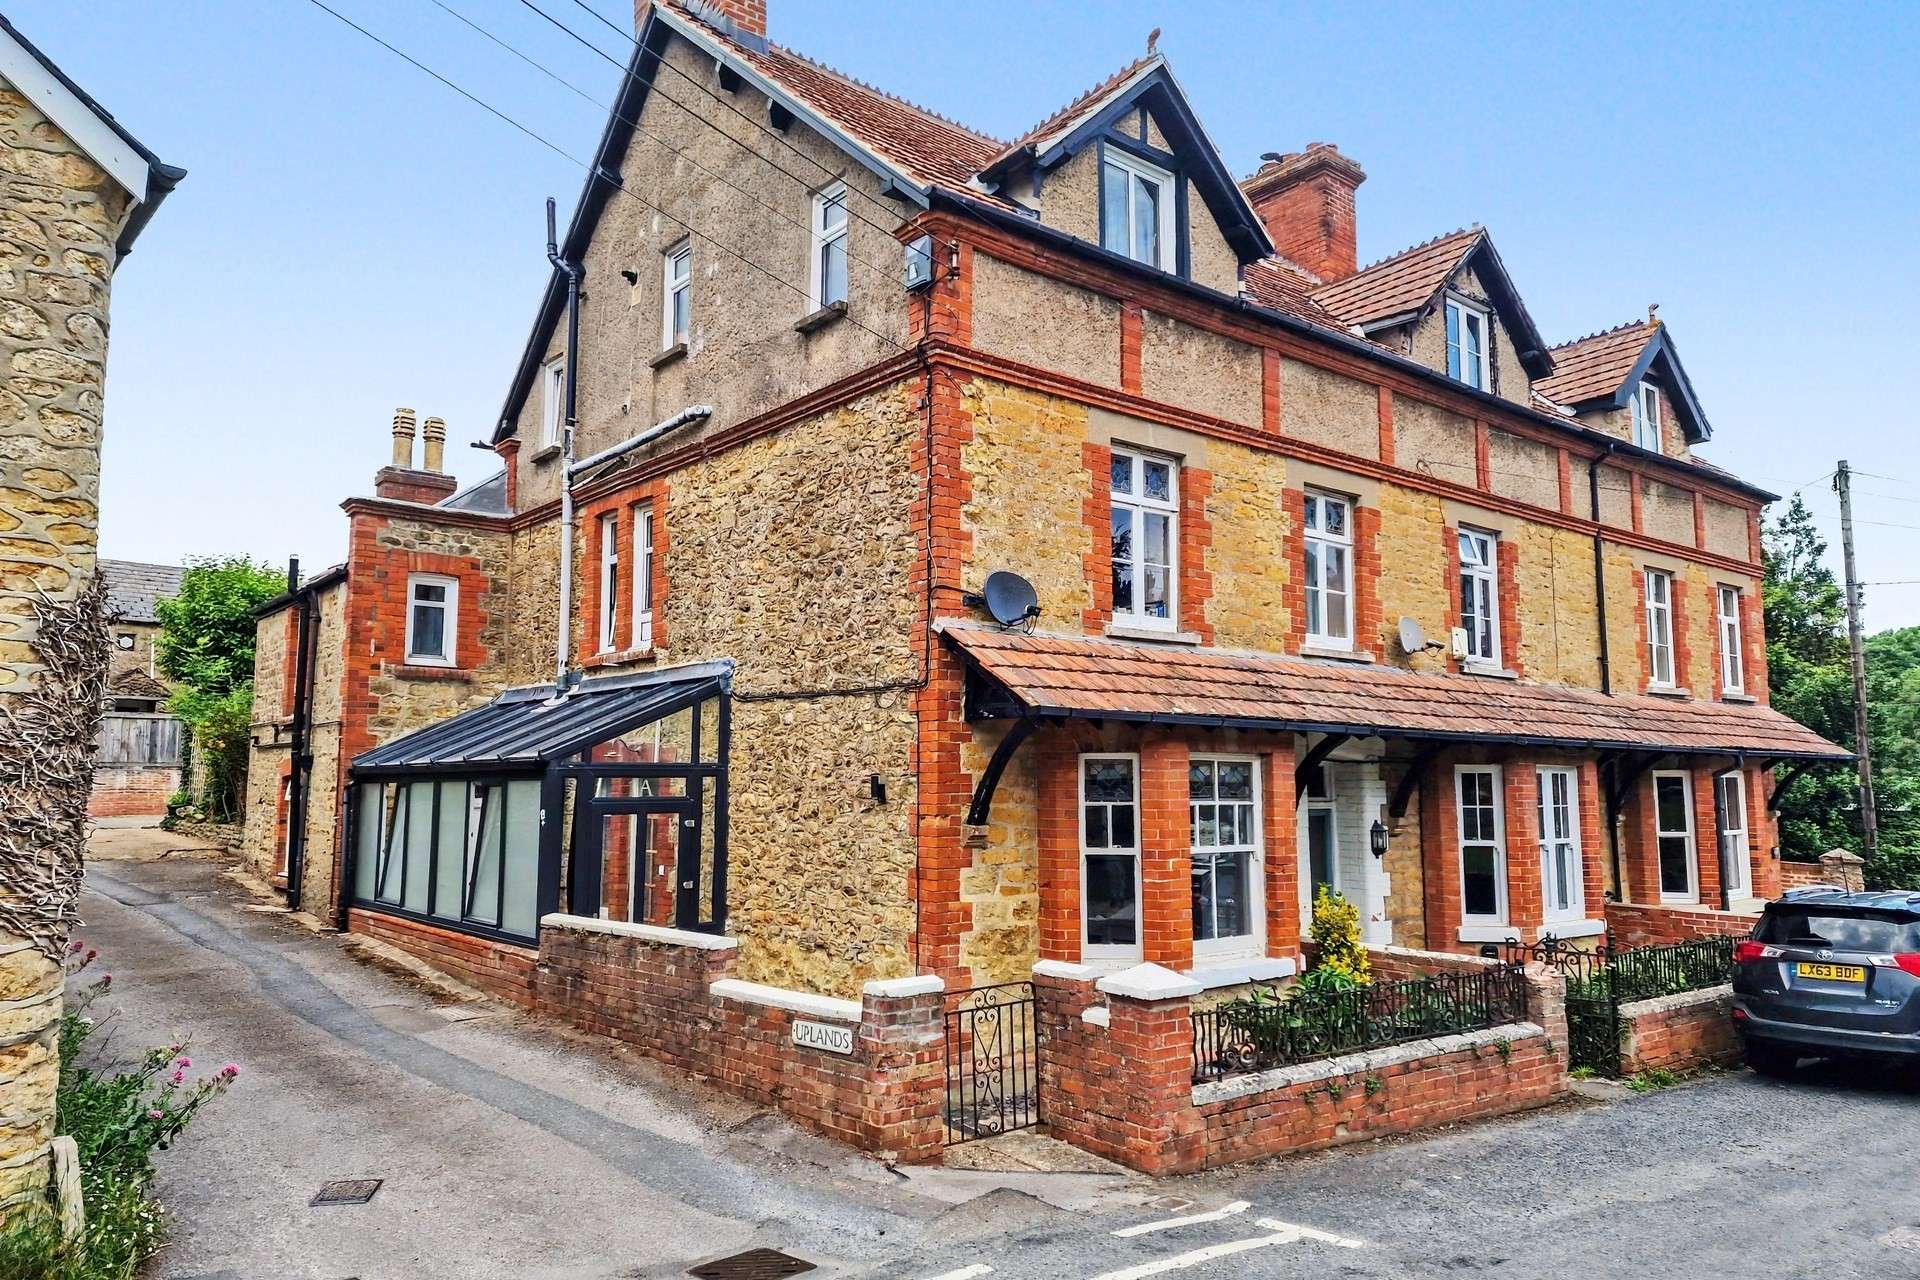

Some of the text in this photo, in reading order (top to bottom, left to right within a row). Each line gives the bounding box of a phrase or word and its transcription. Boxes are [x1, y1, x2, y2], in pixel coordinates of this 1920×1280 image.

[1799, 963, 1861, 979] LX63 BDF
[795, 1023, 850, 1050] UPLANDS
